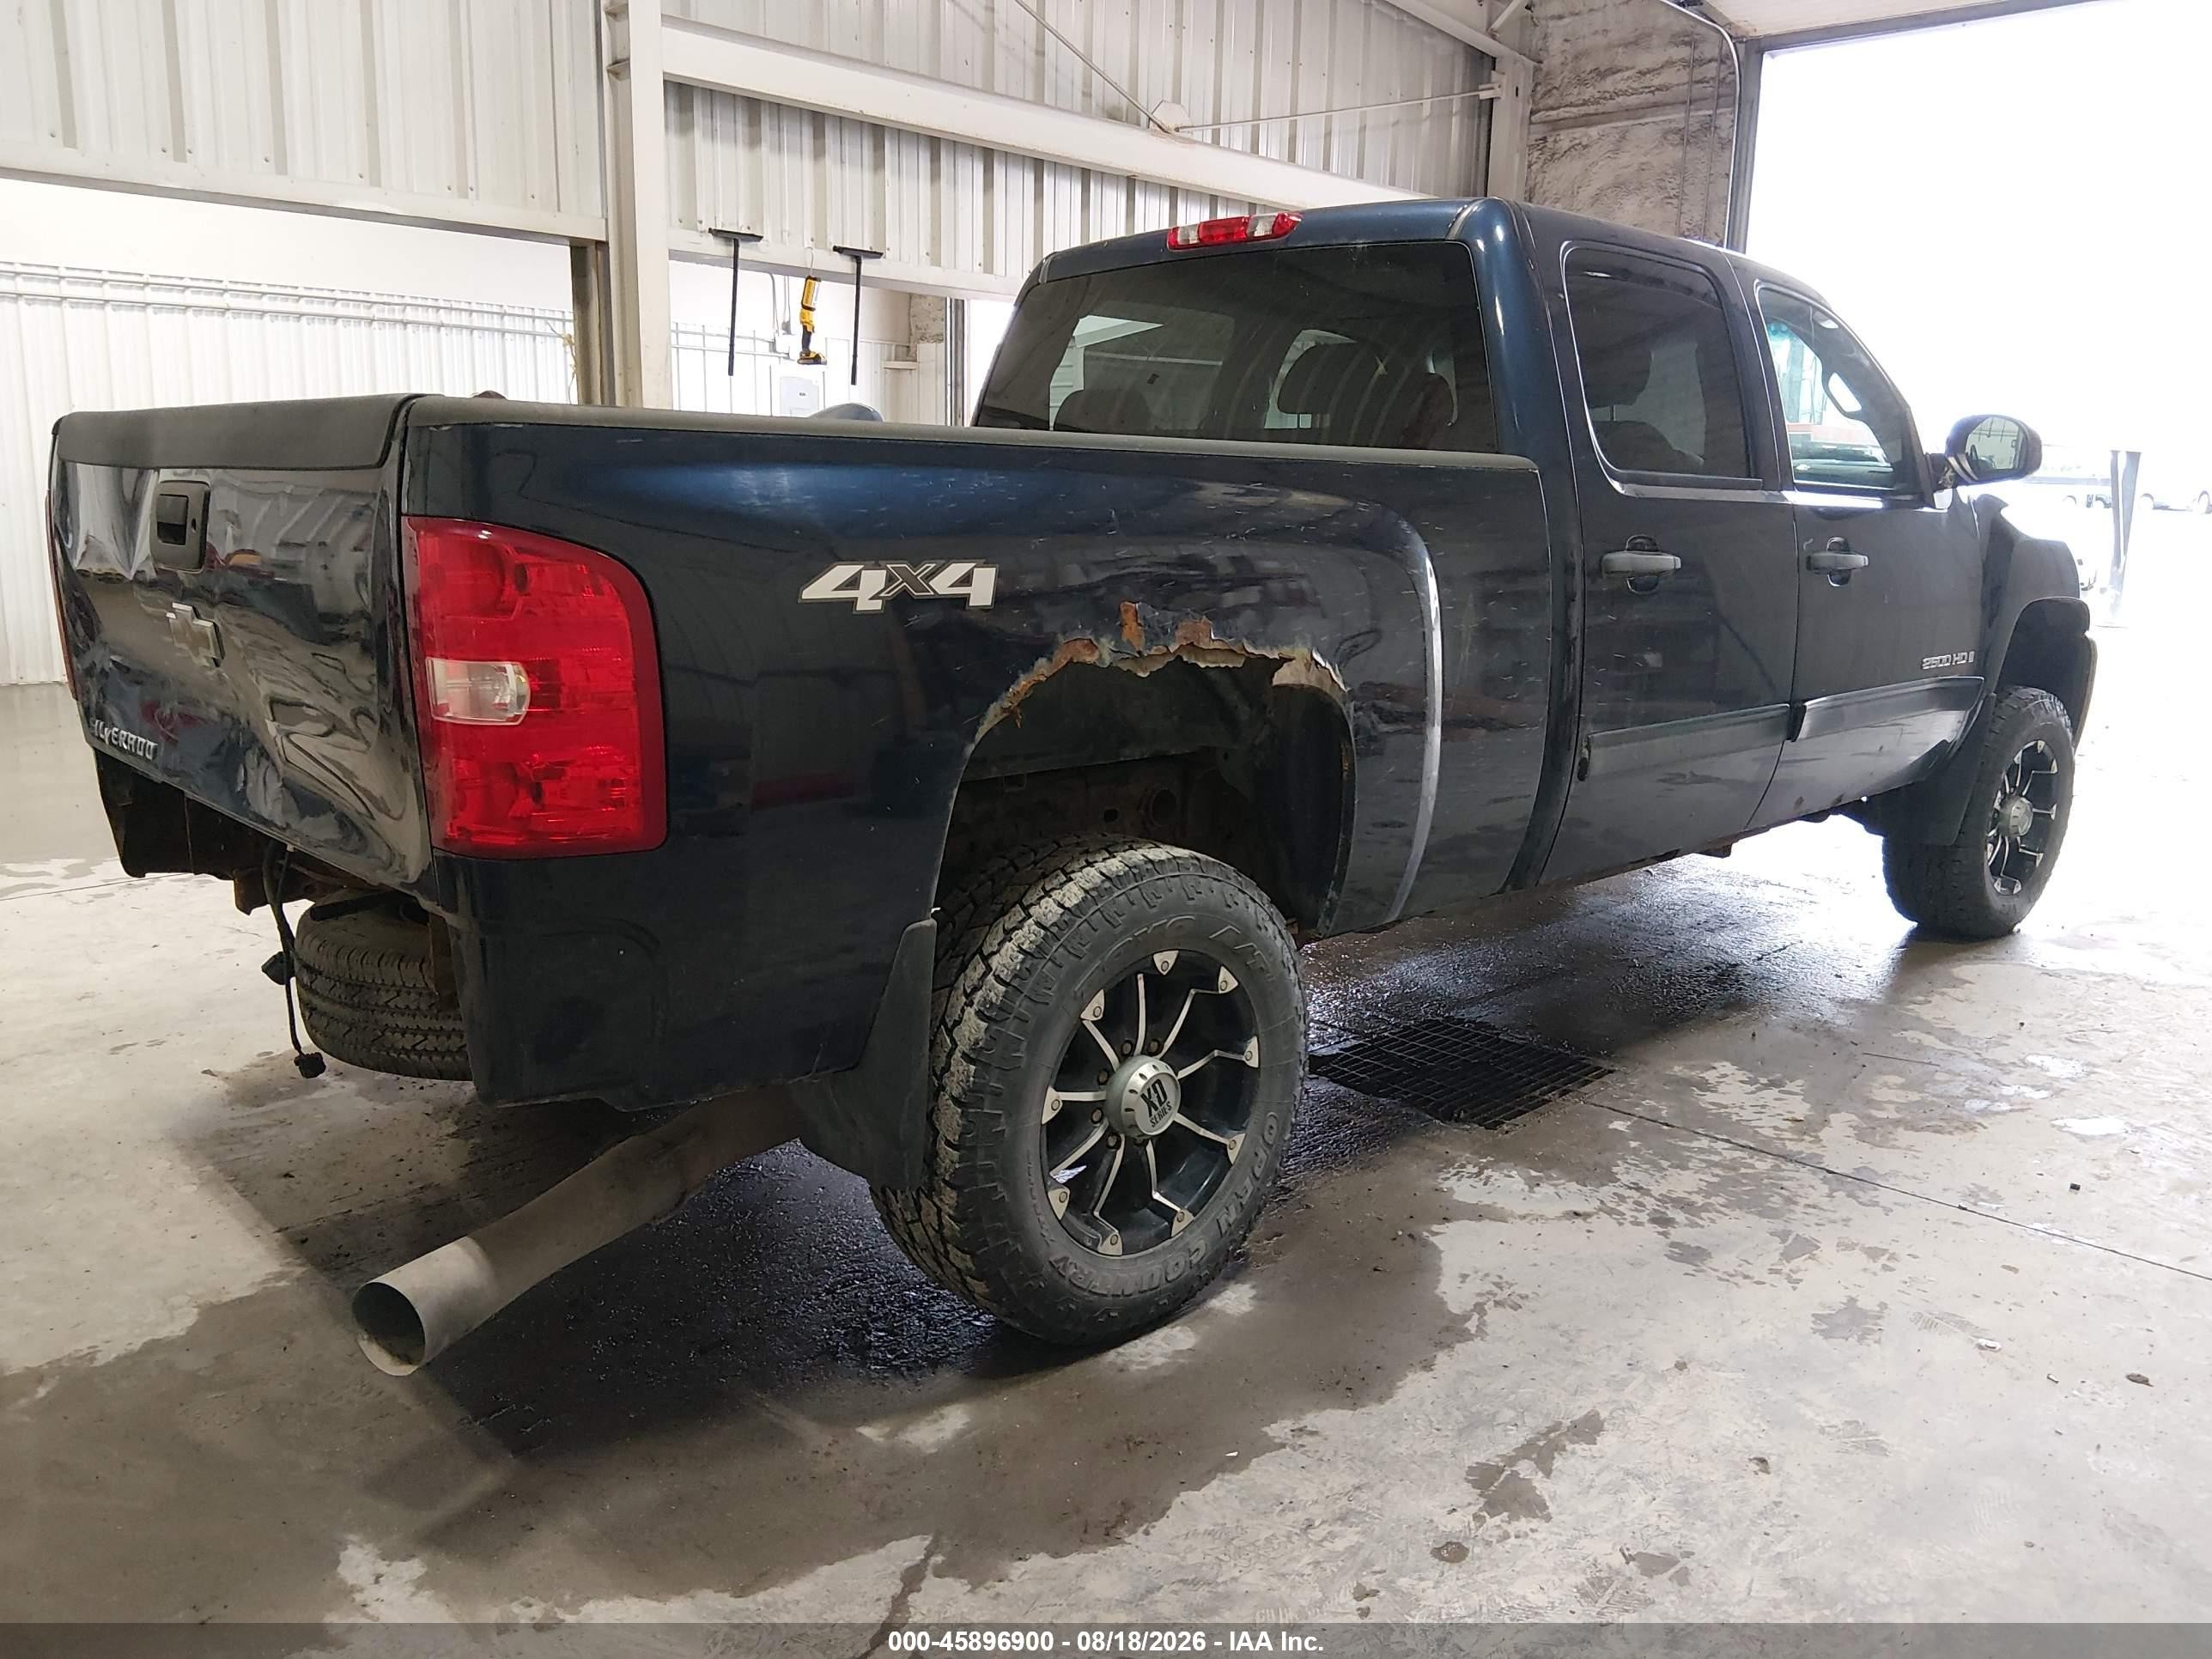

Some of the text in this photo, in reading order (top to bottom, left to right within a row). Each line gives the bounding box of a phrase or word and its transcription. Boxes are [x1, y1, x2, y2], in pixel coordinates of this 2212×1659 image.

[1922, 654, 1952, 670] 2500
[1140, 1079, 1168, 1118] XD
[1150, 1101, 1172, 1127] SERIES
